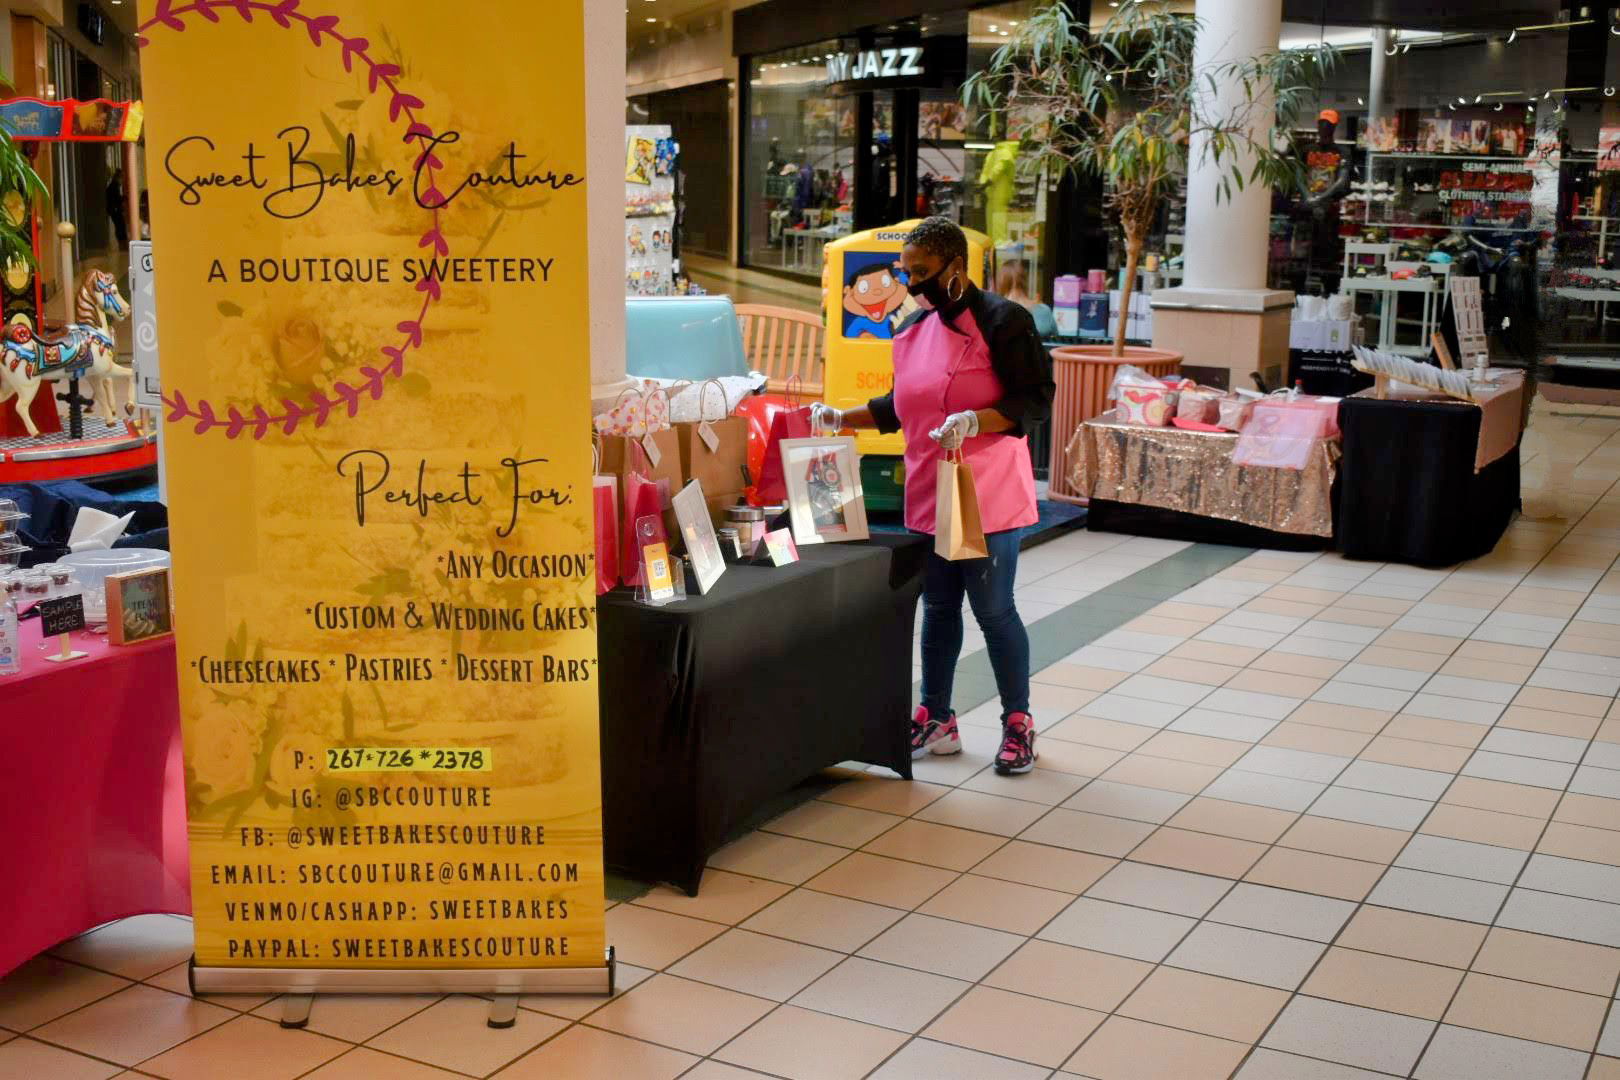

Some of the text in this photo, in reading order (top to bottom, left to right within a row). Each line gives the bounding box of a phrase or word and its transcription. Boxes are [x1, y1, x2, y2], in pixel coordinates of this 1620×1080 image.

[852, 47, 925, 79] JAZZ
[164, 126, 585, 220] Sweet Bakes Couture
[1438, 190, 1485, 201] CLOTHING
[207, 257, 555, 283] A BOUTIQUE SWEETERY
[336, 449, 573, 539] Perfect For:
[48, 614, 79, 631] HERE
[403, 602, 425, 629] &
[293, 751, 315, 770] P:
[291, 786, 492, 812] IG: @SBCCOUTURE
[241, 824, 546, 849] FB: @SWEETBAKESCOUTURE
[210, 862, 579, 885] EMAIL: SBCCOUTURE@GMAIL.COM
[225, 899, 569, 922] VENMO/CASHAPP: SWEETBAKES
[228, 936, 569, 959] PAYPAL: SWEETBAKESCOUTURE
